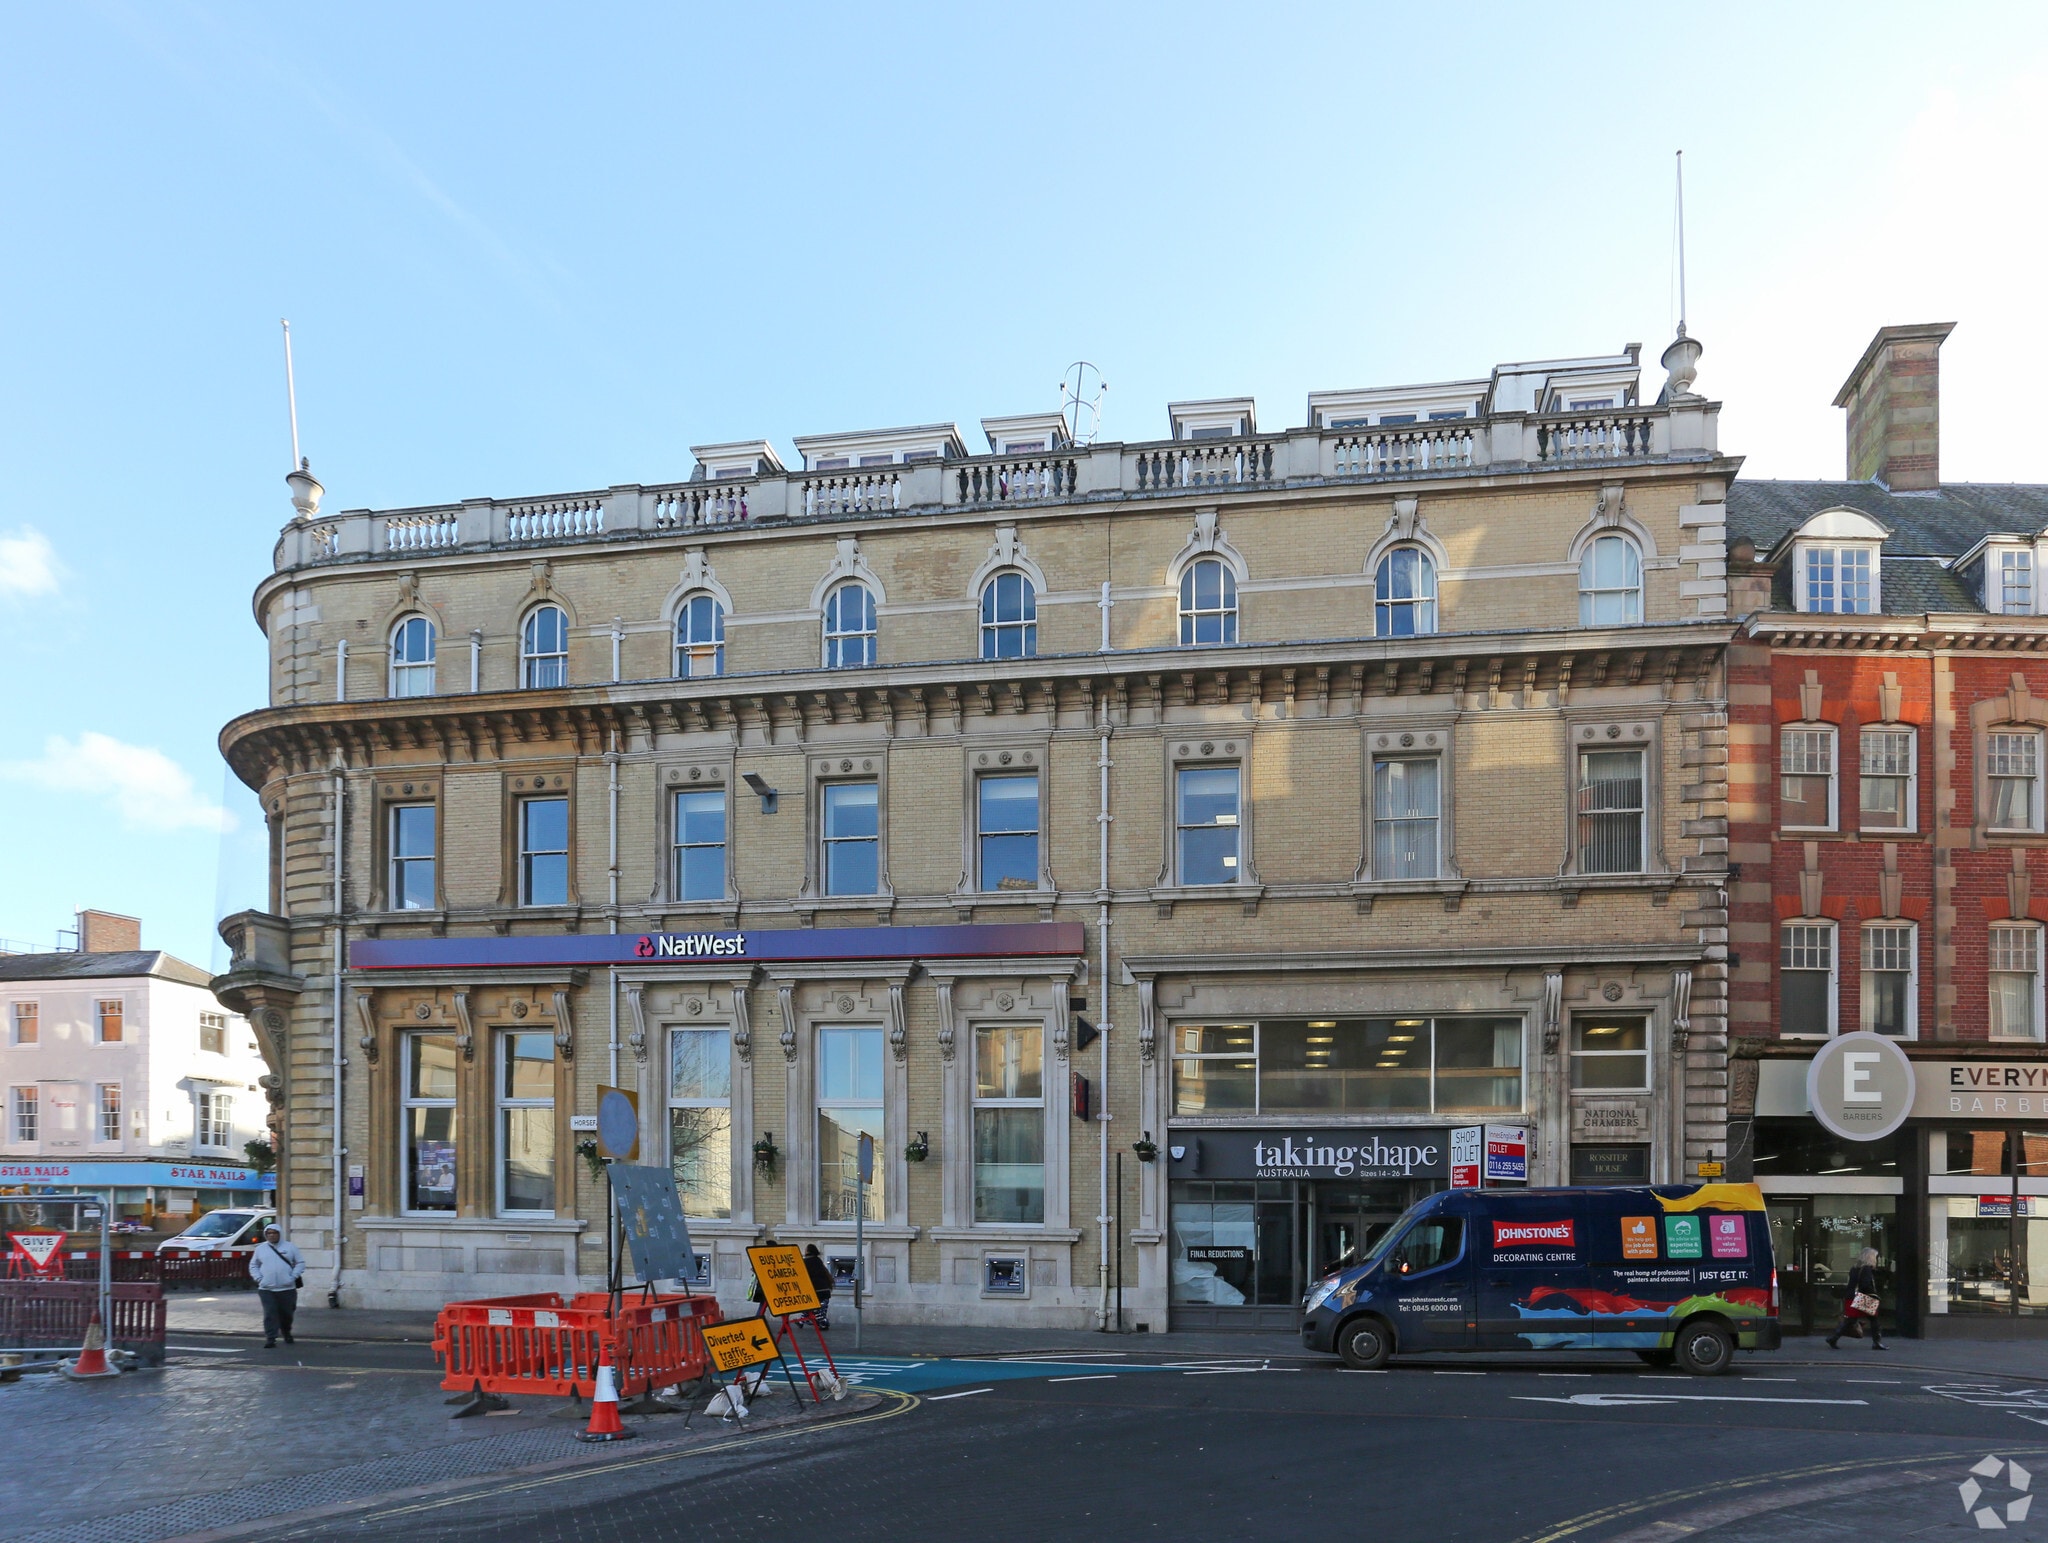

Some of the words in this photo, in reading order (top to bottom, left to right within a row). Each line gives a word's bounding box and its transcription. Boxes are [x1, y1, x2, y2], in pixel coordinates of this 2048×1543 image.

[659, 933, 744, 956] NatWest
[1844, 1052, 1882, 1101] E
[1585, 1110, 1637, 1118] NATIONAL
[1583, 1119, 1639, 1127] CHAMBERS
[1456, 1131, 1475, 1143] SHOP
[1452, 1146, 1462, 1162] TO
[1464, 1145, 1479, 1161] LET
[1489, 1143, 1496, 1153] TO
[1498, 1144, 1508, 1153] LET
[1254, 1136, 1357, 1177] taking
[1359, 1136, 1438, 1175] shape
[1589, 1154, 1628, 1162] ROSSITER
[1, 1167, 31, 1176] STAR
[35, 1167, 70, 1176] NAILS
[1489, 1161, 1501, 1170] 0116
[1512, 1163, 1524, 1171] 5455
[1595, 1165, 1622, 1173] HOUSE
[171, 1168, 205, 1179] STAR
[210, 1170, 246, 1180] NAILS
[1256, 1169, 1311, 1177] AUSTRALIA
[759, 1255, 775, 1265] BUS
[776, 1254, 795, 1264] LANE
[1190, 1250, 1207, 1258] FINAL
[1208, 1250, 1244, 1258] REDUCTIONS
[1494, 1253, 1543, 1262] DECORATING
[1546, 1252, 1576, 1260] CENTRE
[768, 1268, 798, 1279] CAMERA
[1700, 1272, 1718, 1280] JUST
[1720, 1271, 1736, 1279] GET
[776, 1282, 791, 1293] NOT
[773, 1295, 812, 1308] OPERATION
[707, 1330, 745, 1347] Diverted
[719, 1347, 747, 1361] traffic
[723, 1358, 740, 1369] KEEP
[740, 1354, 755, 1364] LEFT
